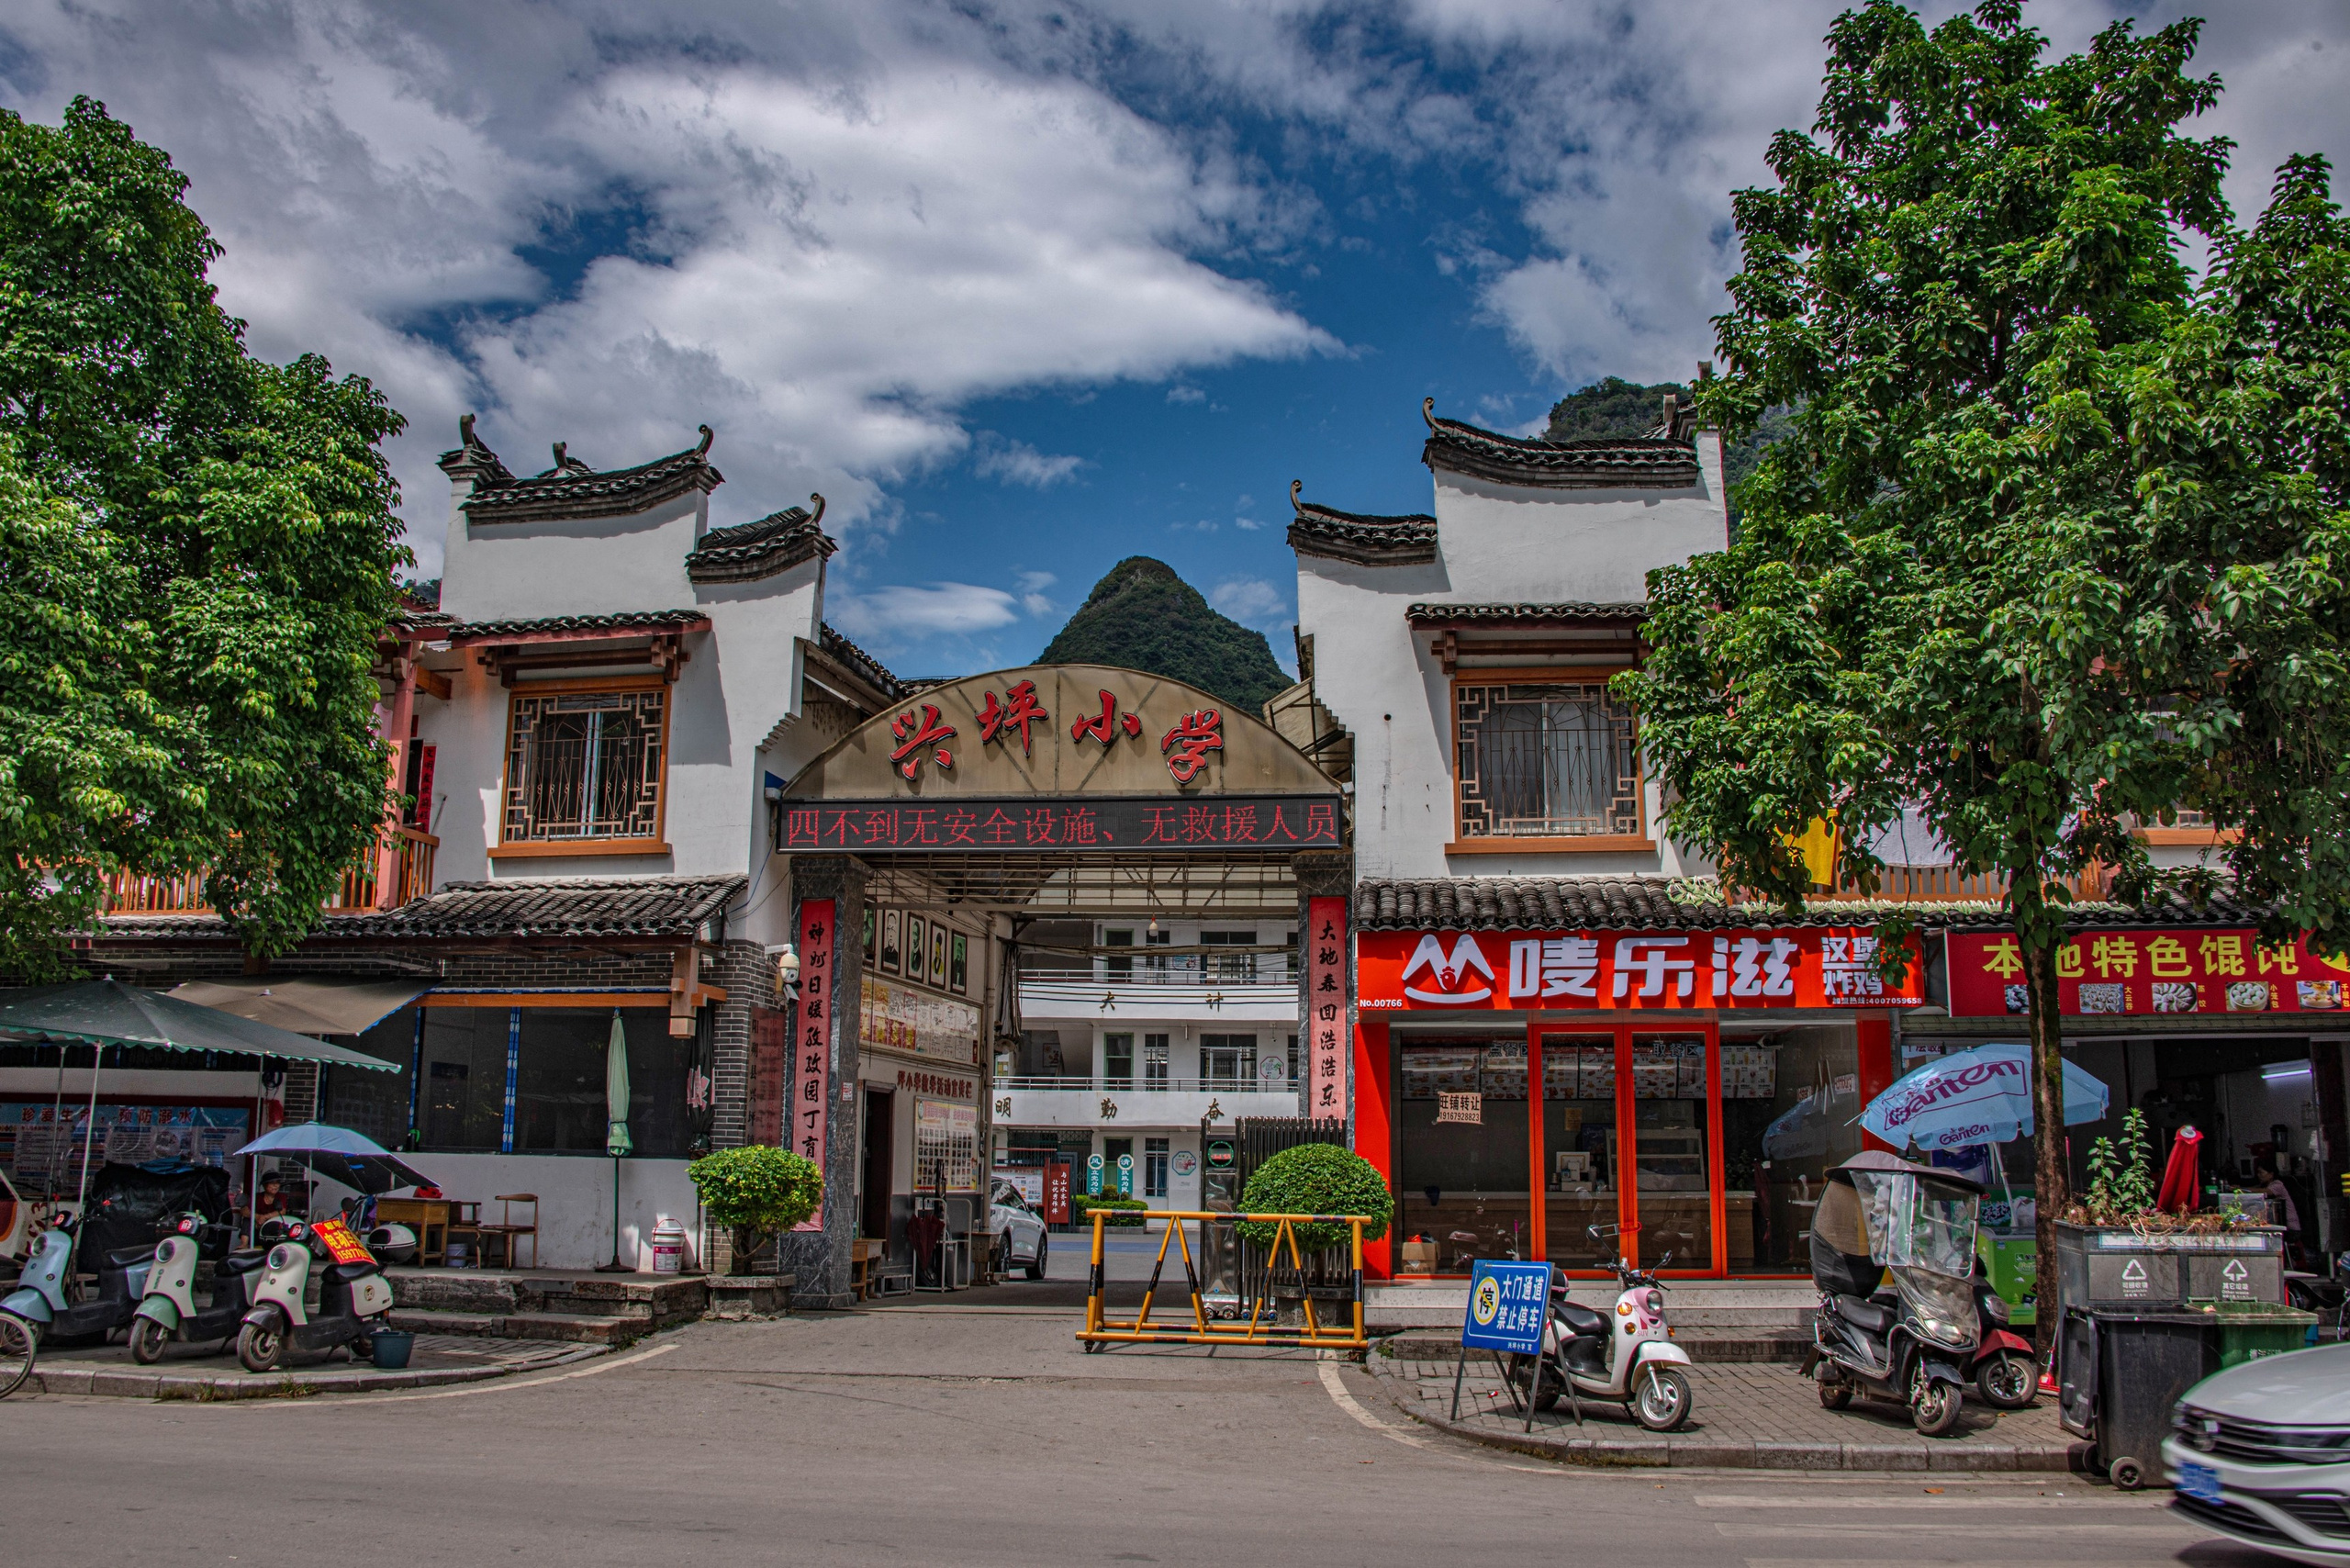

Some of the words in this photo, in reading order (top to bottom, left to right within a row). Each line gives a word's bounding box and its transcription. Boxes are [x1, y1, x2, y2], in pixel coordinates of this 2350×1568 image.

[889, 679, 1225, 785] 兴坪小学
[786, 804, 1337, 847] 四不到无安全设施、无救援人员
[1508, 936, 1798, 998] 唛乐滋
[1823, 969, 1883, 996] 炸鸡
[1360, 999, 1403, 1008] No.00766
[2124, 986, 2133, 1011] 大云吞
[1439, 1095, 1480, 1111] 旺铺转让
[1439, 1111, 1480, 1122] 19167928823
[1501, 1273, 1545, 1302] 大门通道
[1496, 1305, 1539, 1333] 禁止停车
